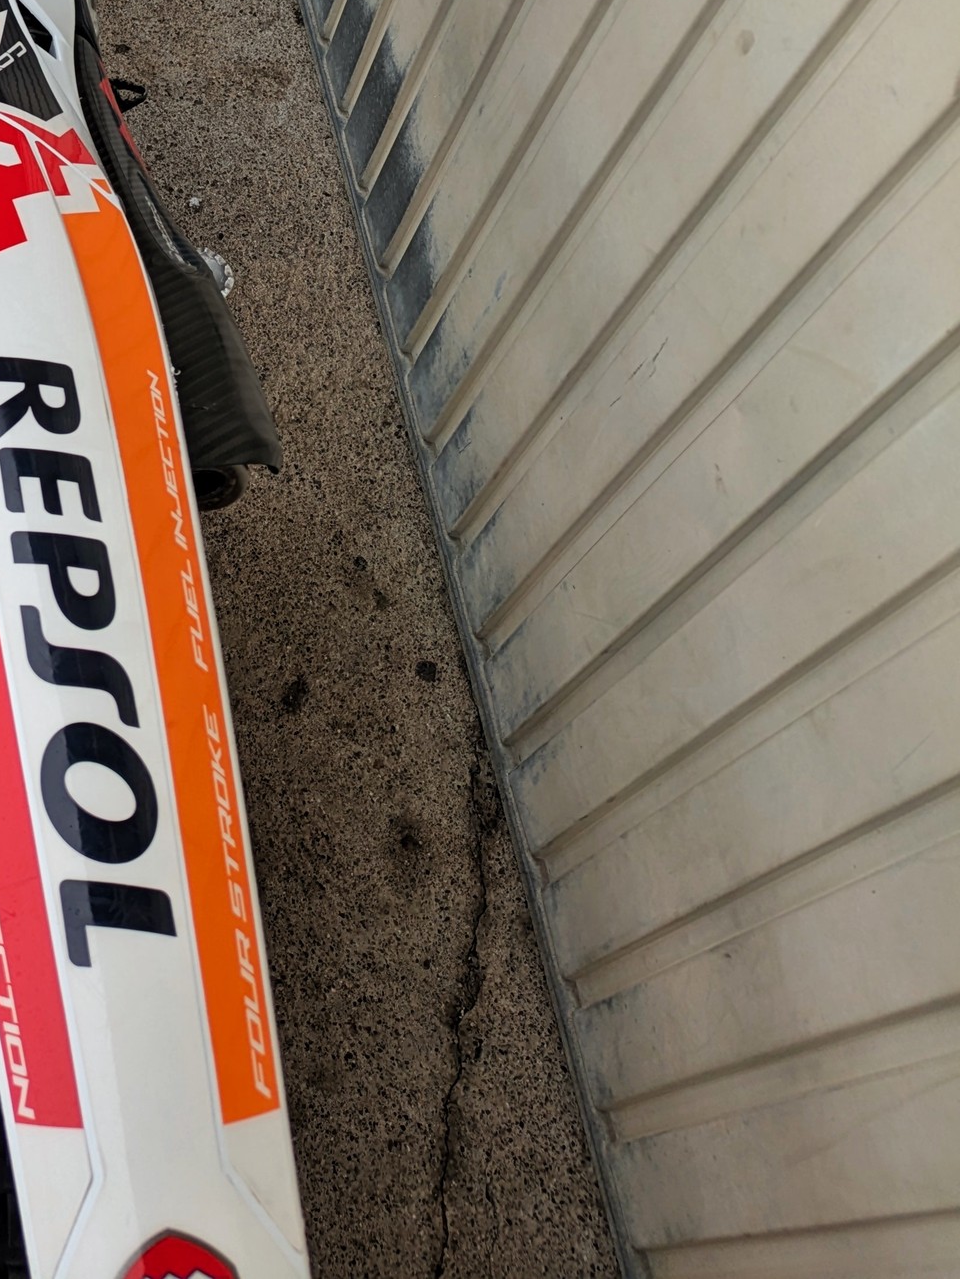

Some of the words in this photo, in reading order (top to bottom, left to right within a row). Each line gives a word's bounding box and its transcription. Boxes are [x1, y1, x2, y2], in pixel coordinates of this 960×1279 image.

[147, 371, 188, 550] INJECTION
[179, 558, 209, 672] FUEL
[206, 711, 247, 920] STROKE
[235, 930, 272, 1100] FOUR
